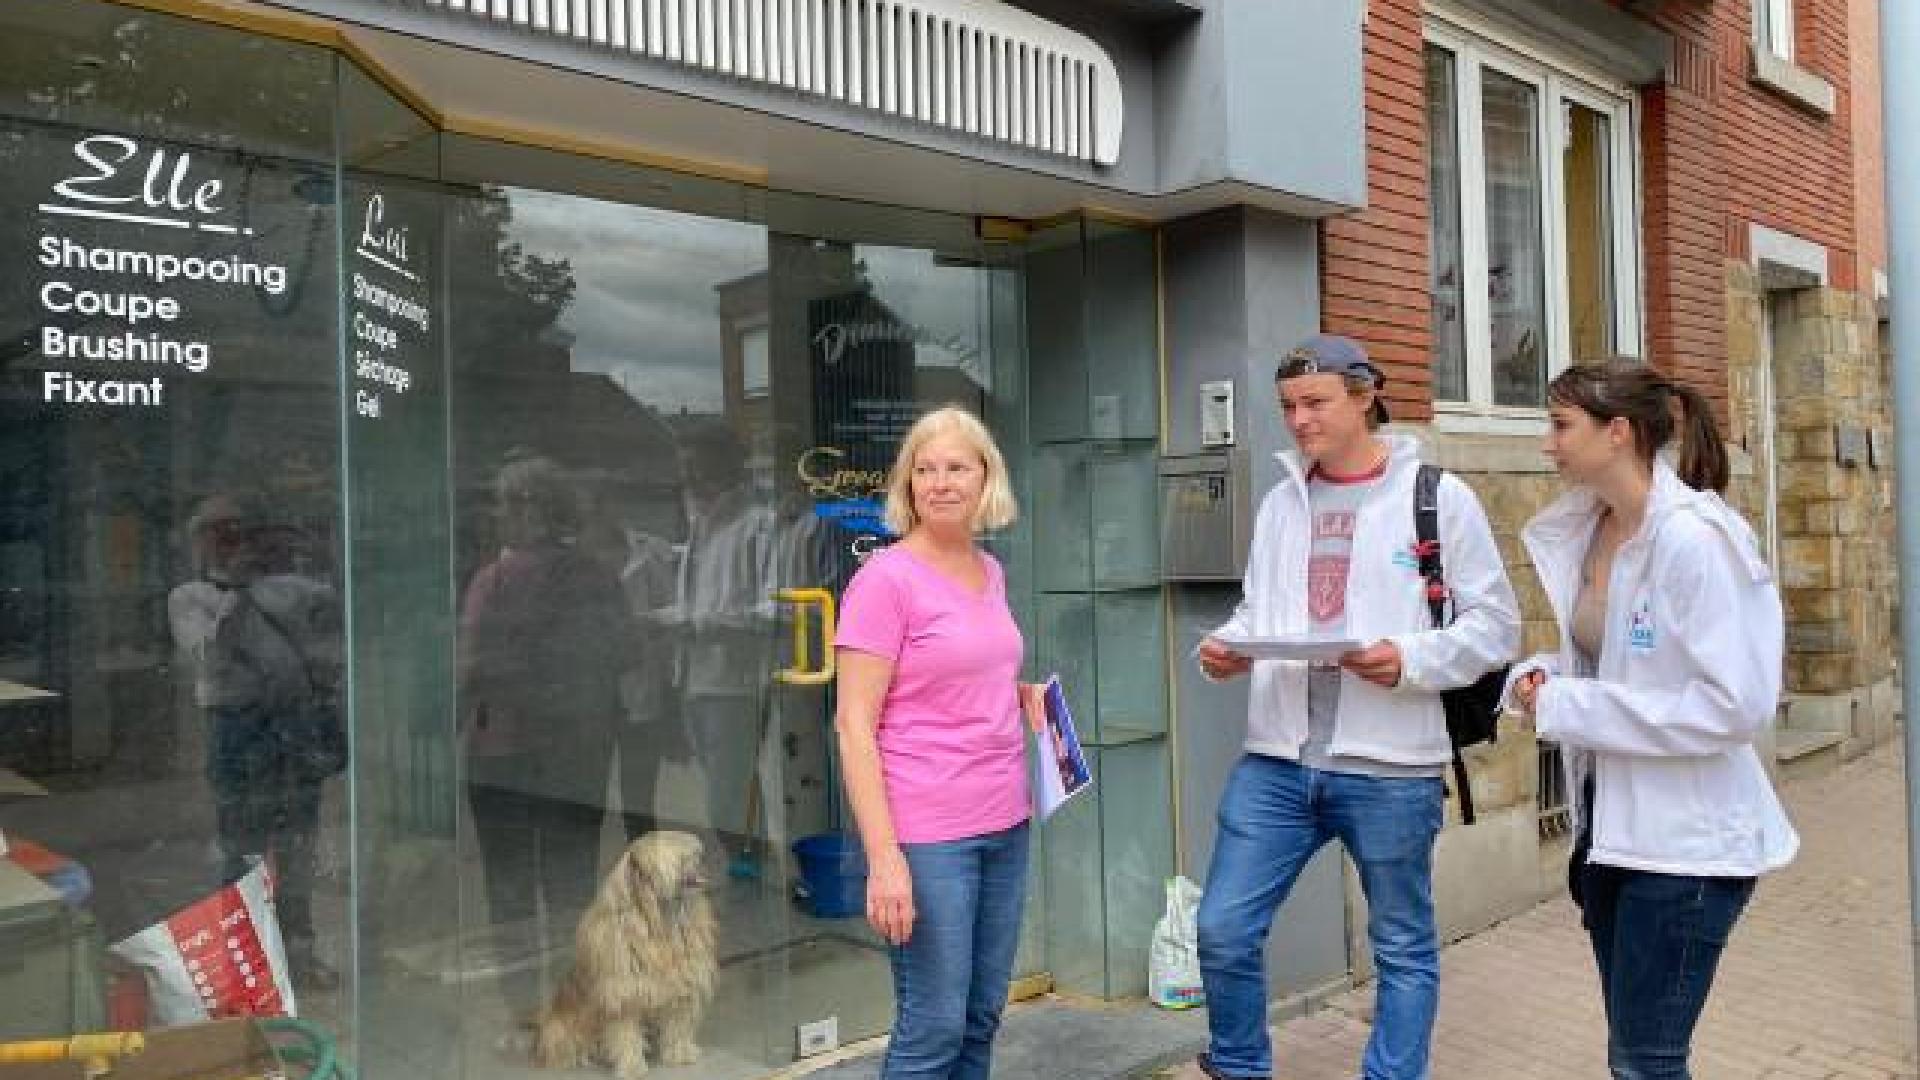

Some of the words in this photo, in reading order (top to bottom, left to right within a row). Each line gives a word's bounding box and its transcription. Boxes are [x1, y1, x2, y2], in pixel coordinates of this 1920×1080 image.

[53, 135, 223, 213] Elle
[361, 194, 409, 262] Lui
[39, 237, 288, 294] Shampooing
[41, 281, 180, 324] Coupe
[353, 273, 430, 332] Shampooing
[41, 326, 209, 373] Brushing
[354, 311, 397, 351] Coupe
[44, 371, 163, 406] Fixant
[356, 389, 382, 418] Gel
